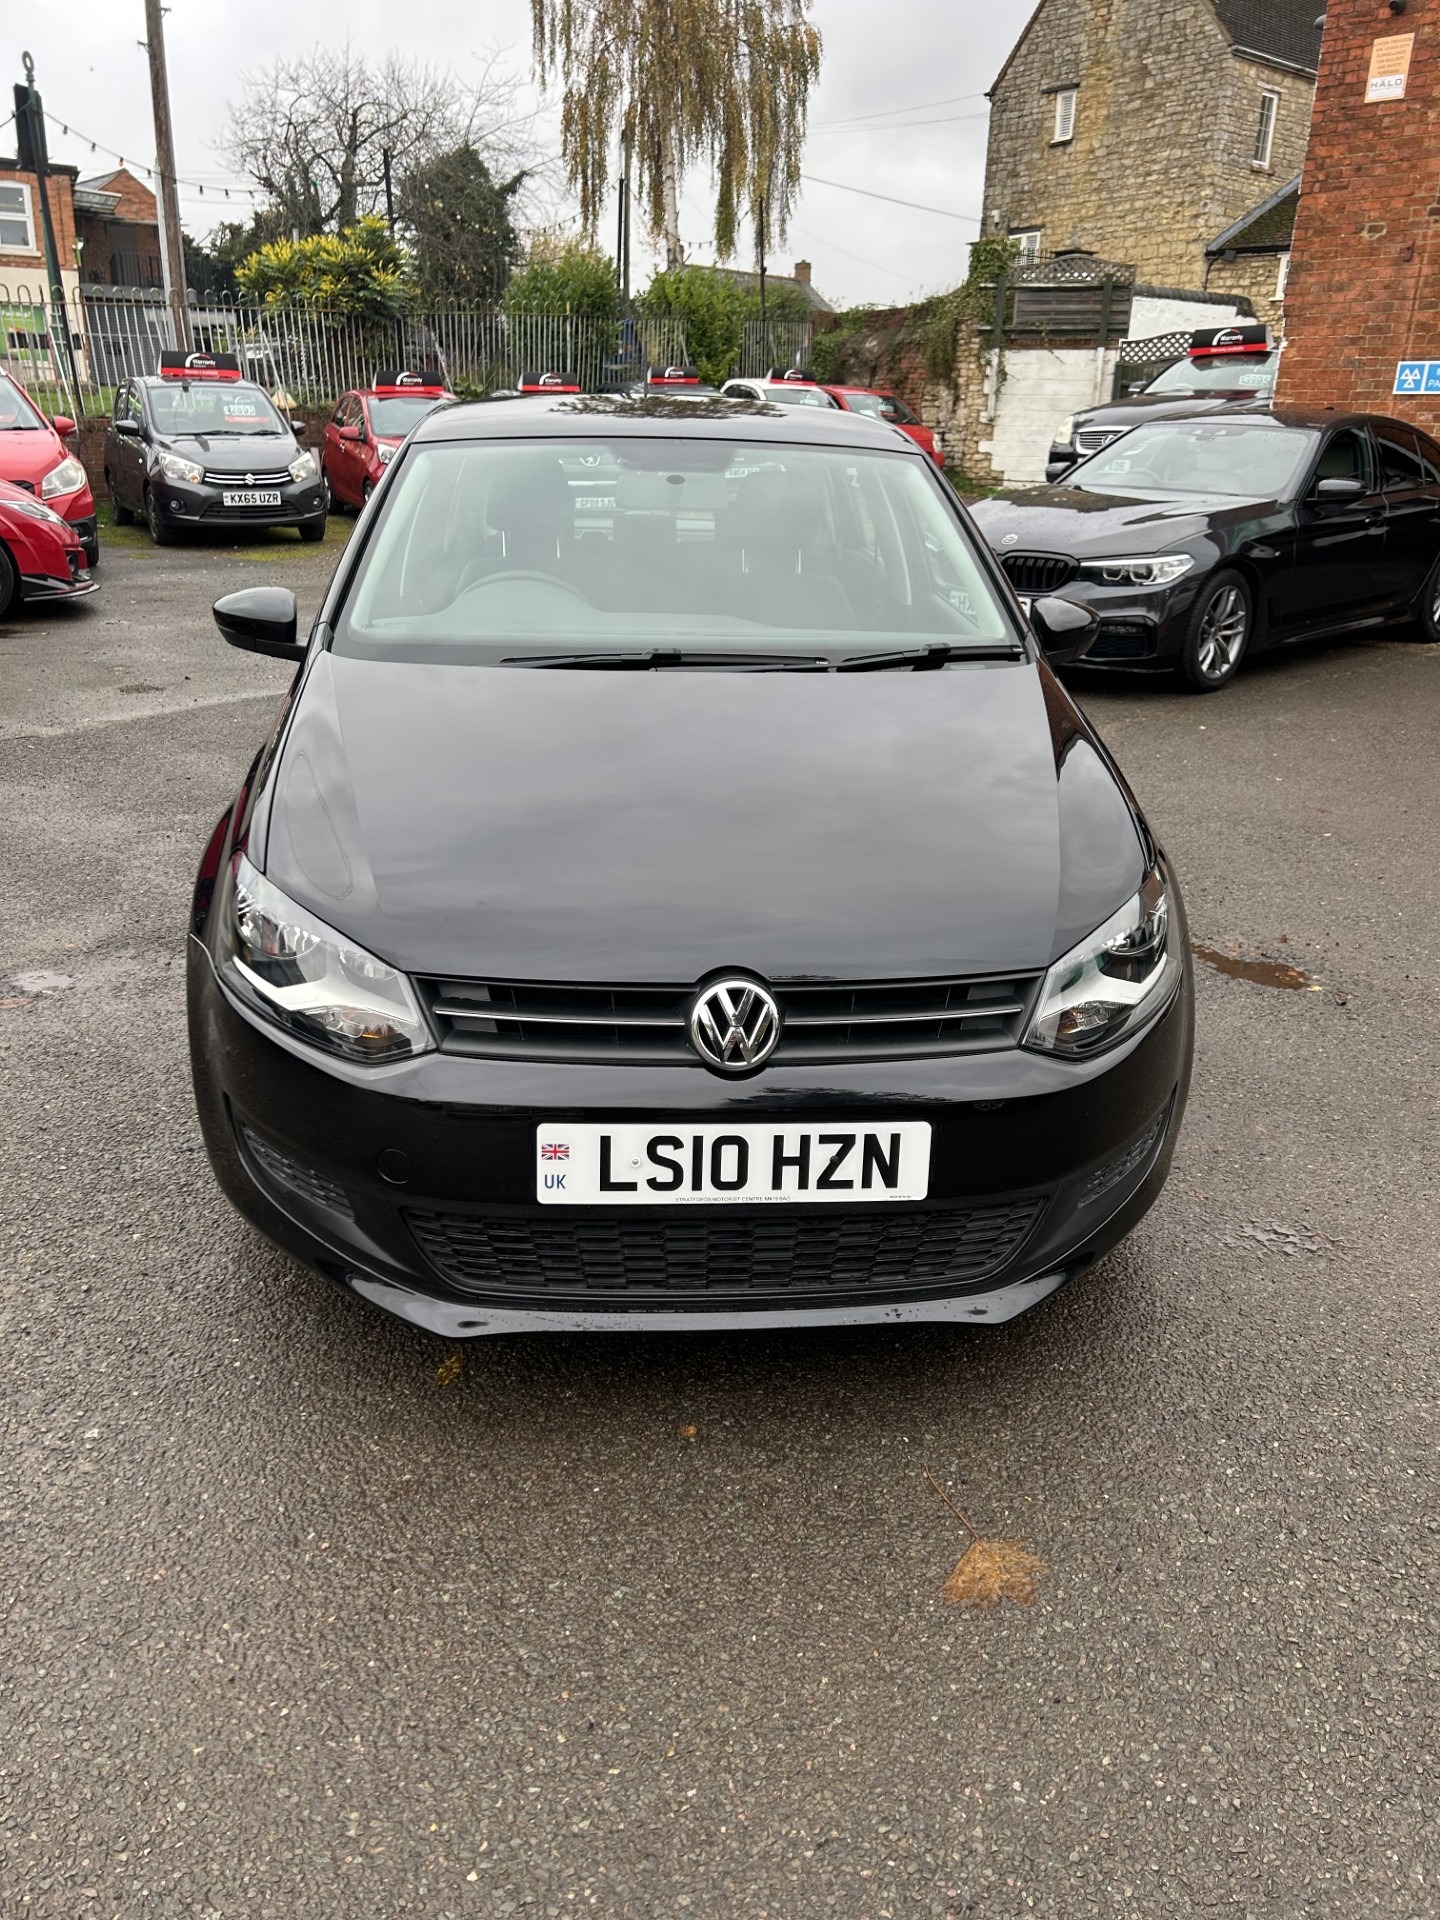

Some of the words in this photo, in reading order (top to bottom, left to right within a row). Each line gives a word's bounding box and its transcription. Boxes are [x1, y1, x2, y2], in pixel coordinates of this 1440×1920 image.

[1220, 334, 1244, 342] Warranty
[230, 493, 257, 504] KX65
[259, 493, 278, 504] UZR
[600, 1135, 749, 1191] LS10
[772, 1133, 901, 1190] HZN
[544, 1174, 566, 1189] UK
